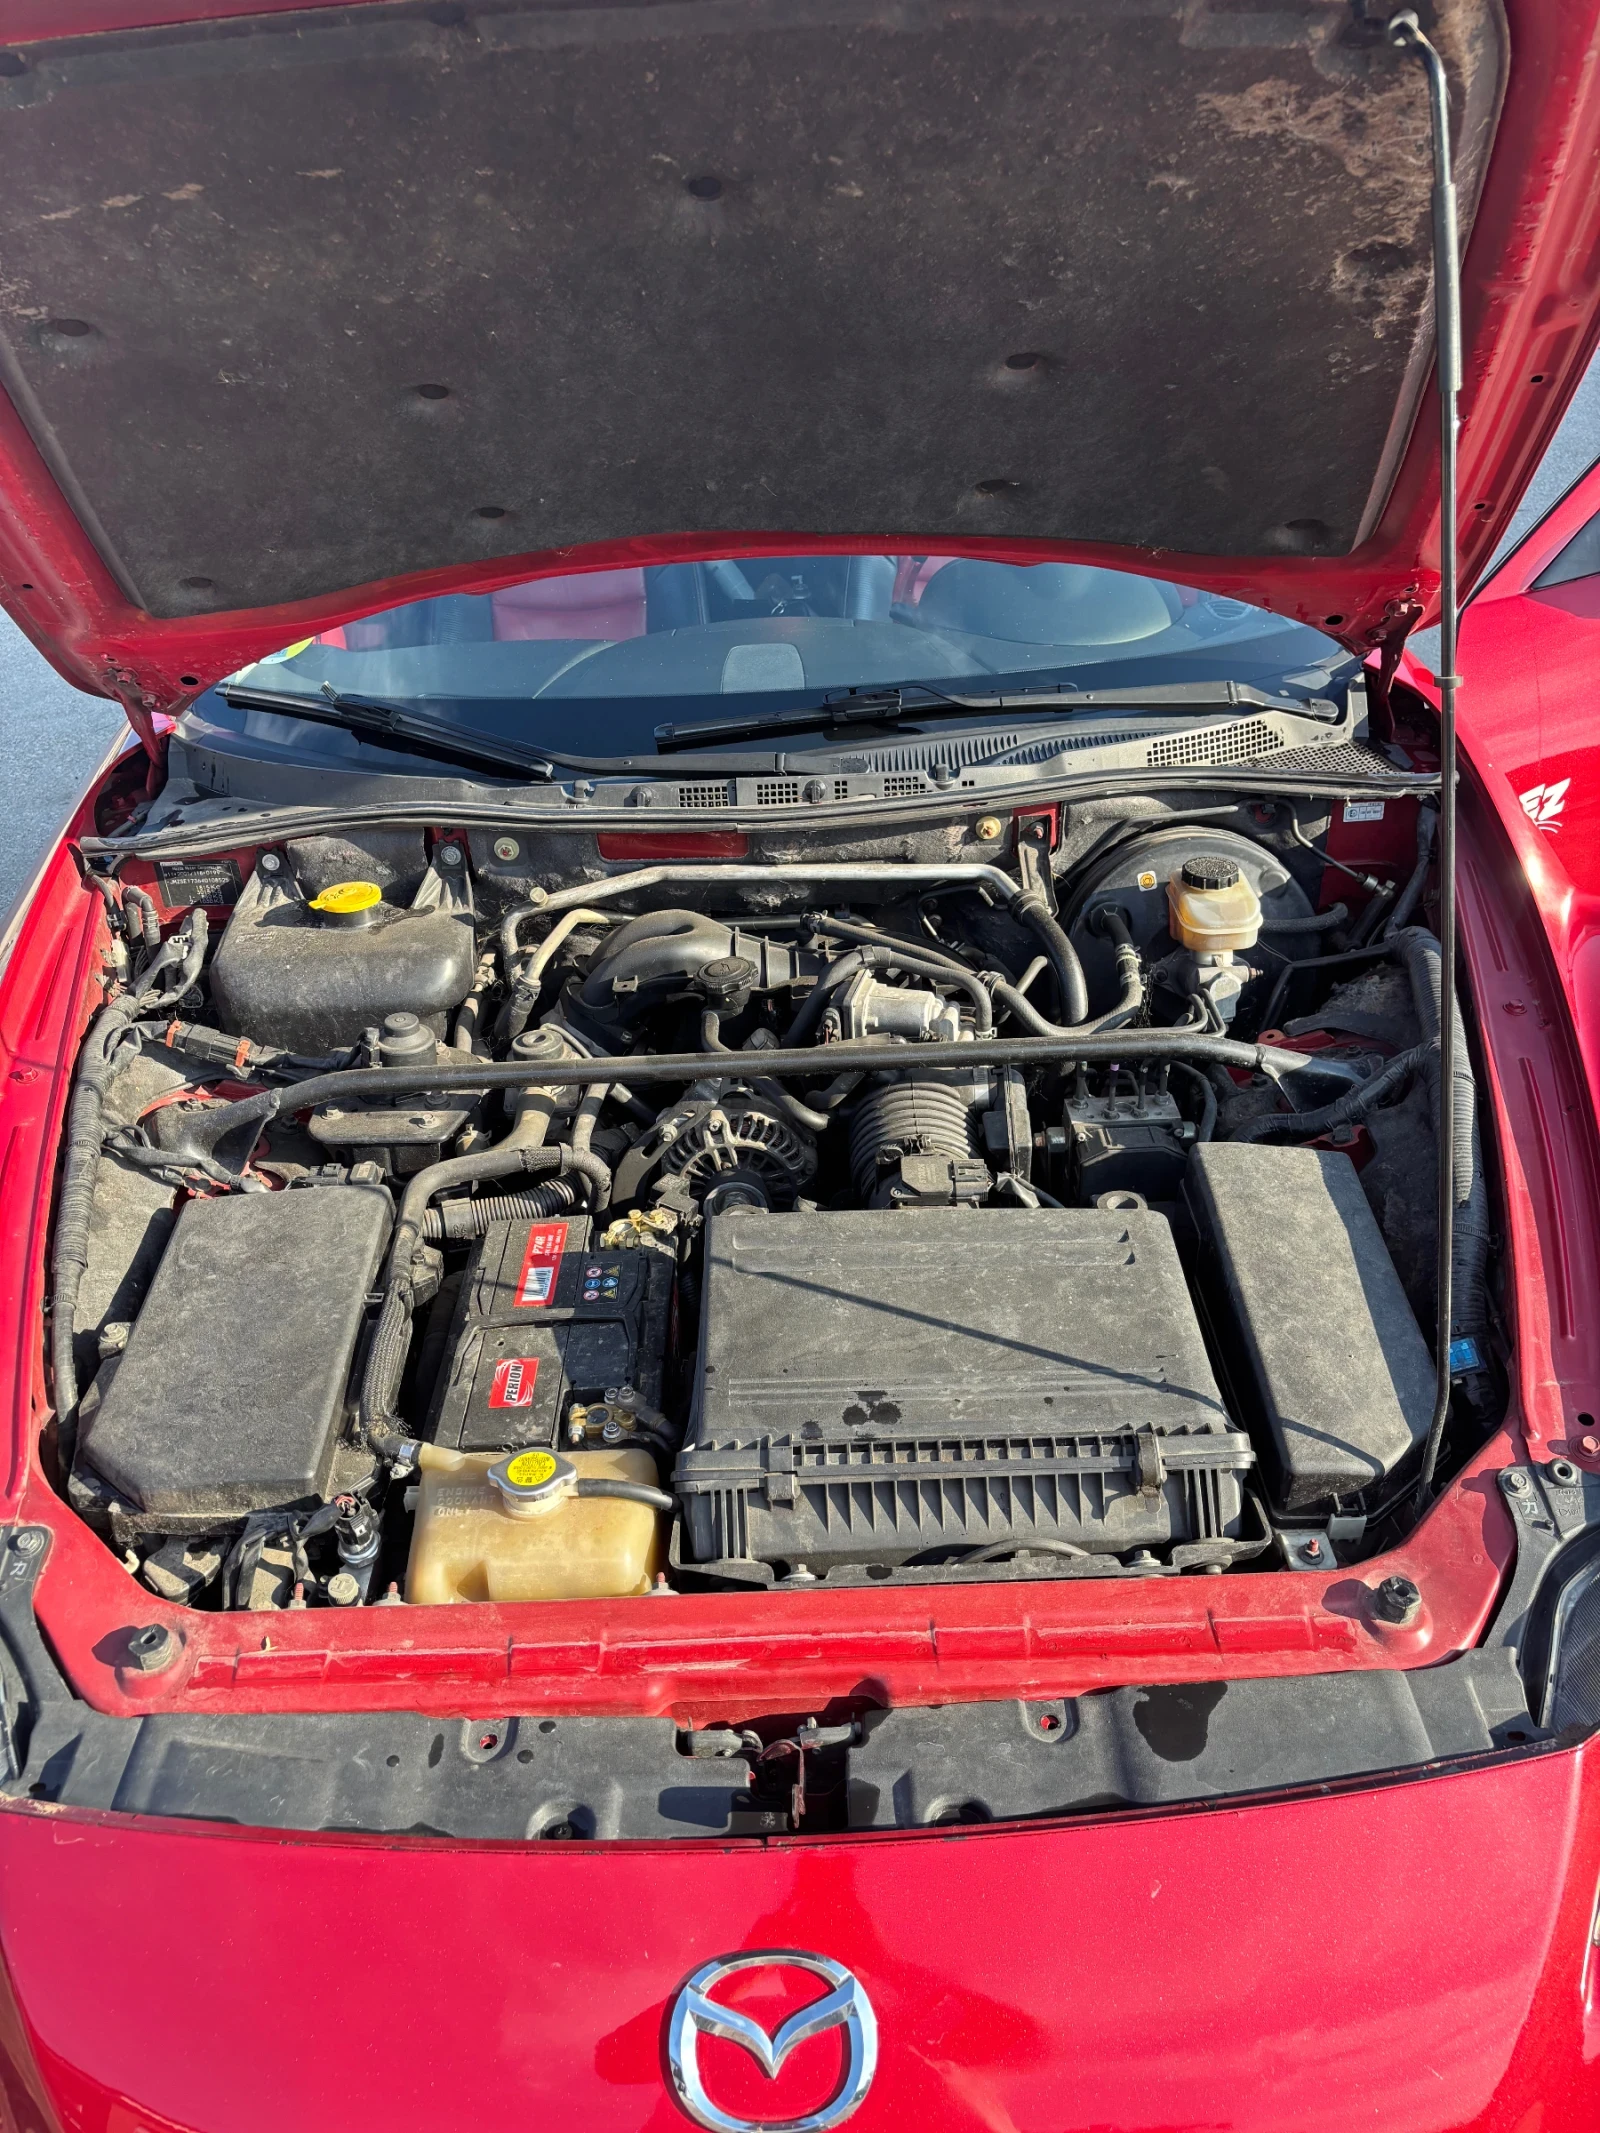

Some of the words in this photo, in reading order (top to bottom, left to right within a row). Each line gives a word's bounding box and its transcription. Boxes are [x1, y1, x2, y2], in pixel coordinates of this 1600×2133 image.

[532, 1236, 546, 1254] P74R
[505, 1365, 523, 1401] PERION
[437, 1486, 486, 1497] ENGINE
[438, 1494, 496, 1505] COOLANT
[436, 1506, 472, 1517] ONLY
